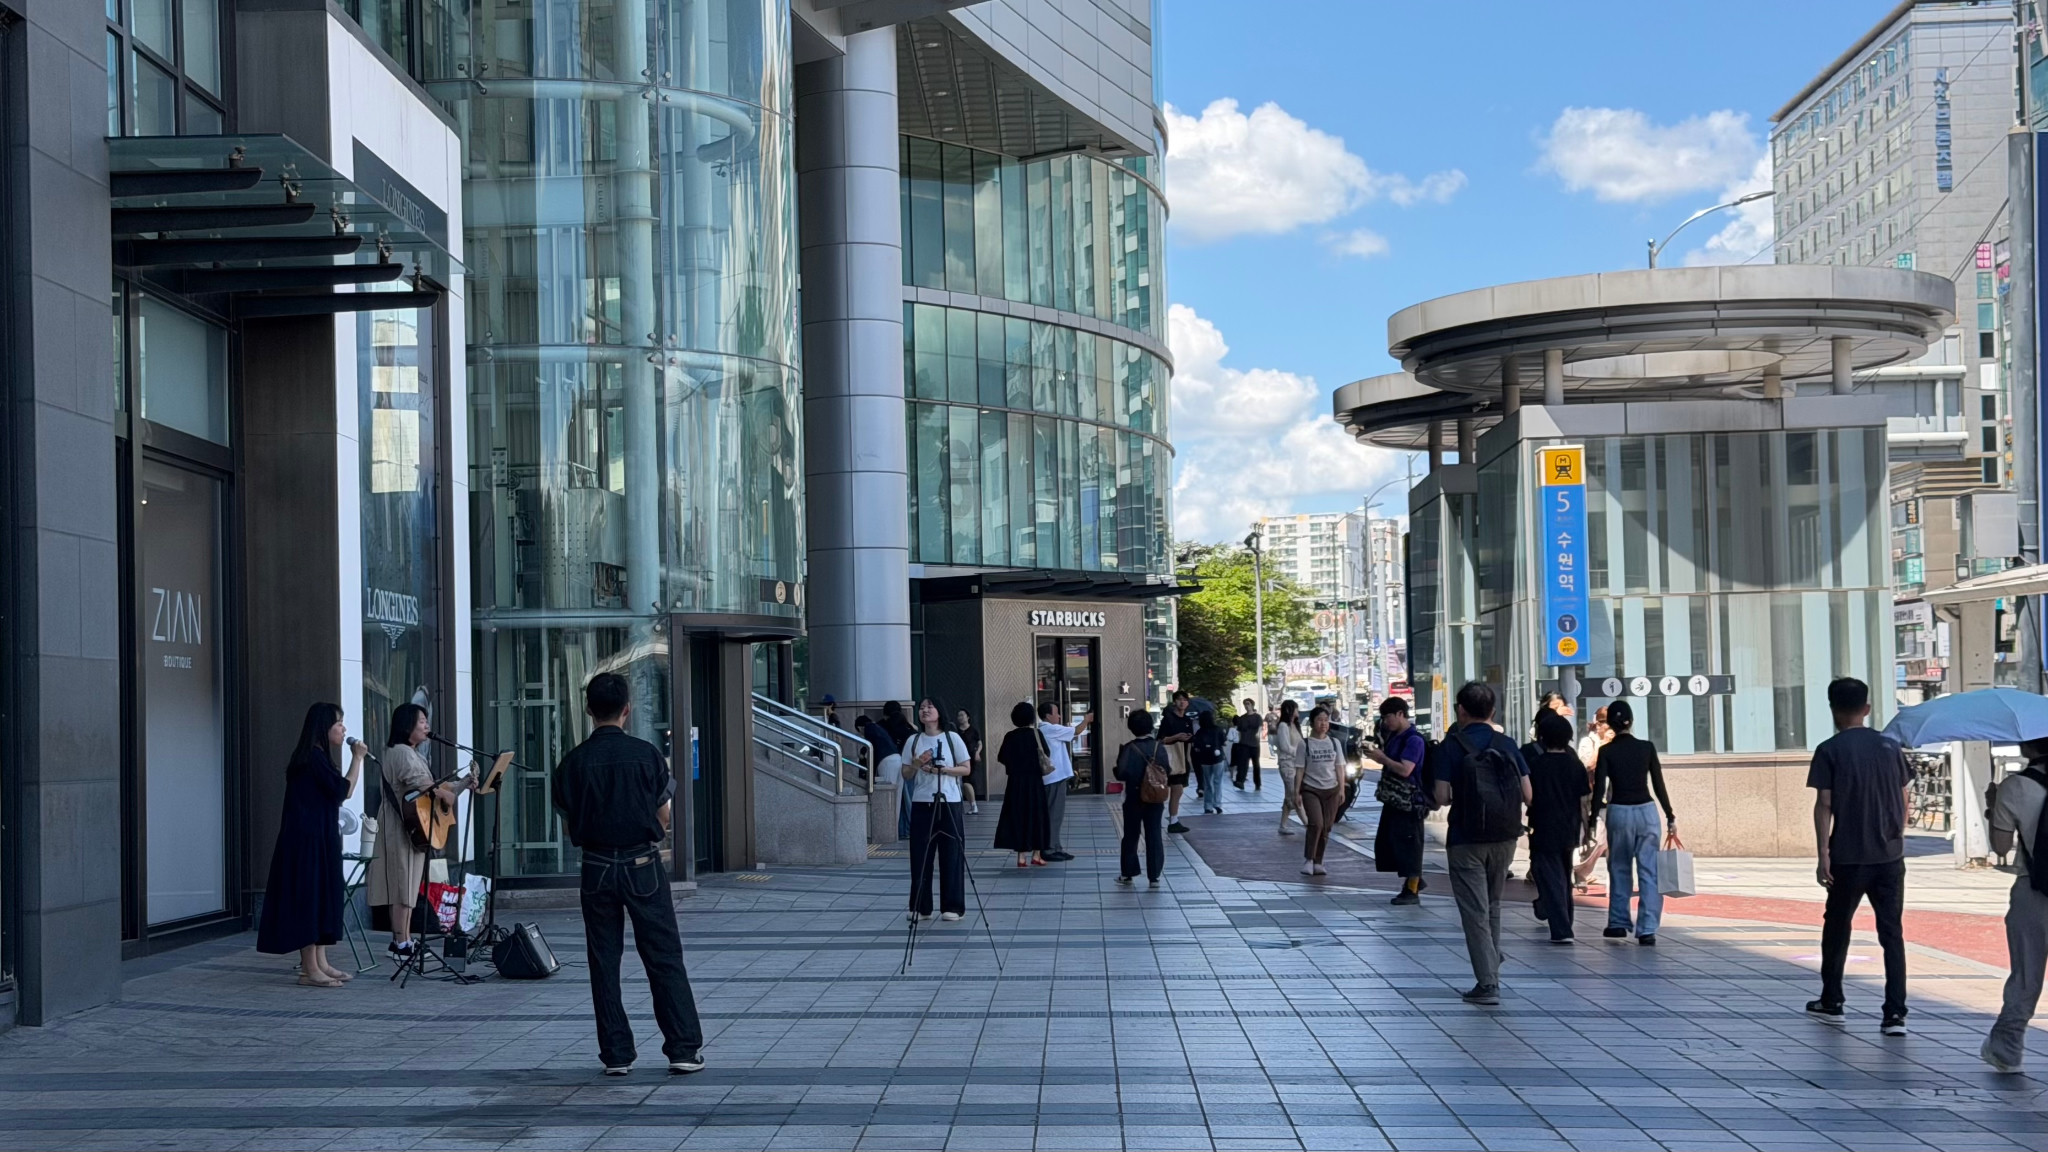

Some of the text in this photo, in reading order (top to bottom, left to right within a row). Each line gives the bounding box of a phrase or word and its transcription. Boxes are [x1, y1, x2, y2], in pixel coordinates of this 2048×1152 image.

[382, 178, 426, 234] LONGINES
[1557, 491, 1570, 512] 5
[1557, 532, 1574, 592] 수원역
[152, 587, 202, 645] ZIAN
[367, 587, 419, 626] LONGINES
[1031, 610, 1106, 627] STARBUCKS
[1564, 621, 1570, 631] 1
[163, 654, 192, 669] BOUTIQUE
